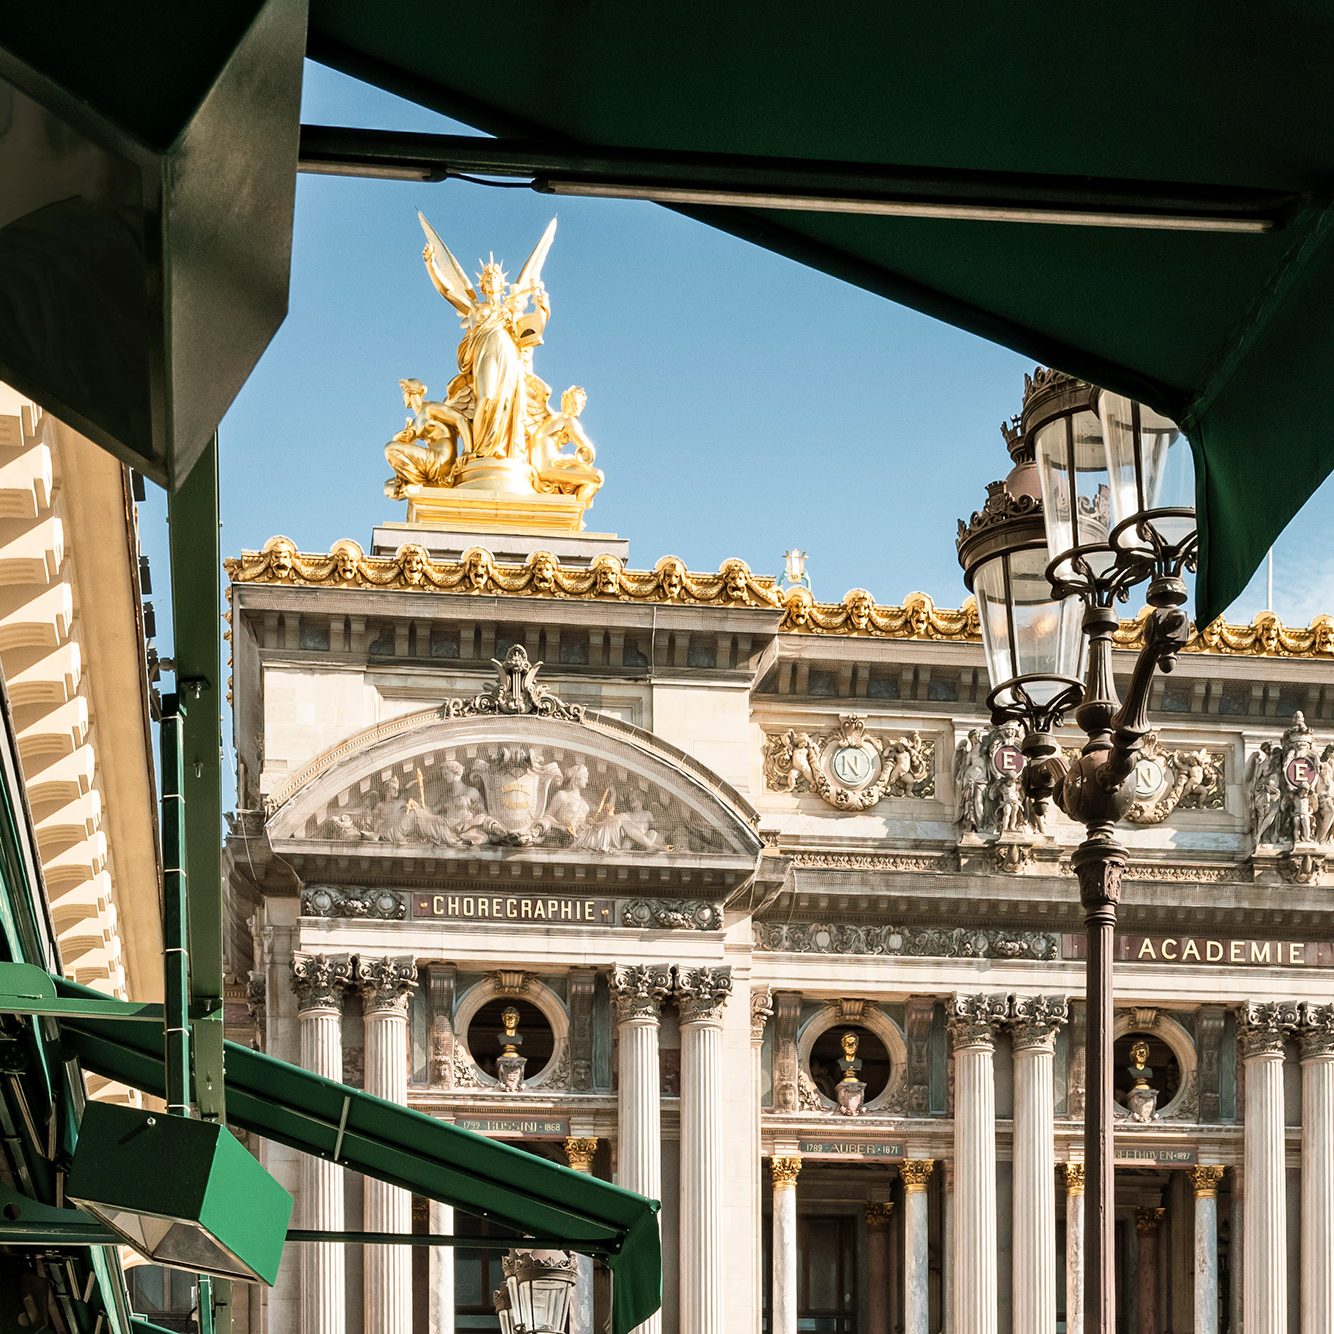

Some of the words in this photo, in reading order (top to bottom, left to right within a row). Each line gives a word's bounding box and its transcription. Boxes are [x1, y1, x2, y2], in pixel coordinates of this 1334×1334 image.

[840, 755, 861, 777] N
[1002, 751, 1017, 770] E
[1294, 763, 1308, 781] E
[433, 895, 596, 920] CHOREGRAPHIE
[1137, 937, 1306, 964] ACADEMIE
[544, 1123, 561, 1132] 1868
[830, 1143, 876, 1154] AUBER
[882, 1145, 898, 1154] 1871
[1114, 1149, 1173, 1160] BEETHOVEN
